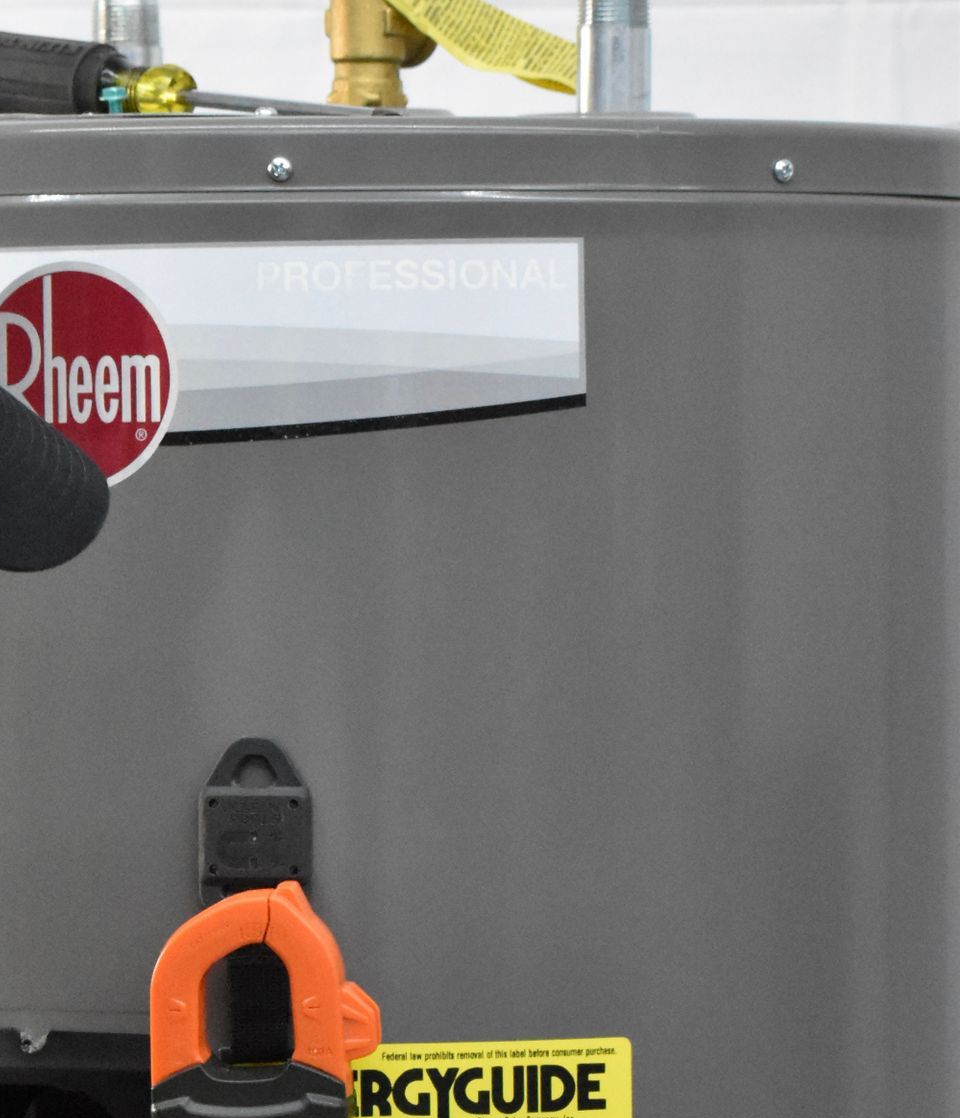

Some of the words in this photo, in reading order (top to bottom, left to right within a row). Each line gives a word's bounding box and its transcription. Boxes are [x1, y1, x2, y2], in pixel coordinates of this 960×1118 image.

[256, 257, 566, 296] PROFESSIONAL
[382, 1052, 407, 1062] Federal
[409, 1052, 422, 1061] law
[424, 1051, 455, 1062] prohibits
[456, 1051, 484, 1060] removal
[486, 1050, 494, 1059] of
[495, 1050, 508, 1059] this
[510, 1049, 526, 1058] label
[528, 1048, 550, 1058] before
[552, 1048, 583, 1058] consumer
[586, 1047, 617, 1059] purchase.
[352, 1063, 607, 1118] RGYGUIDE
